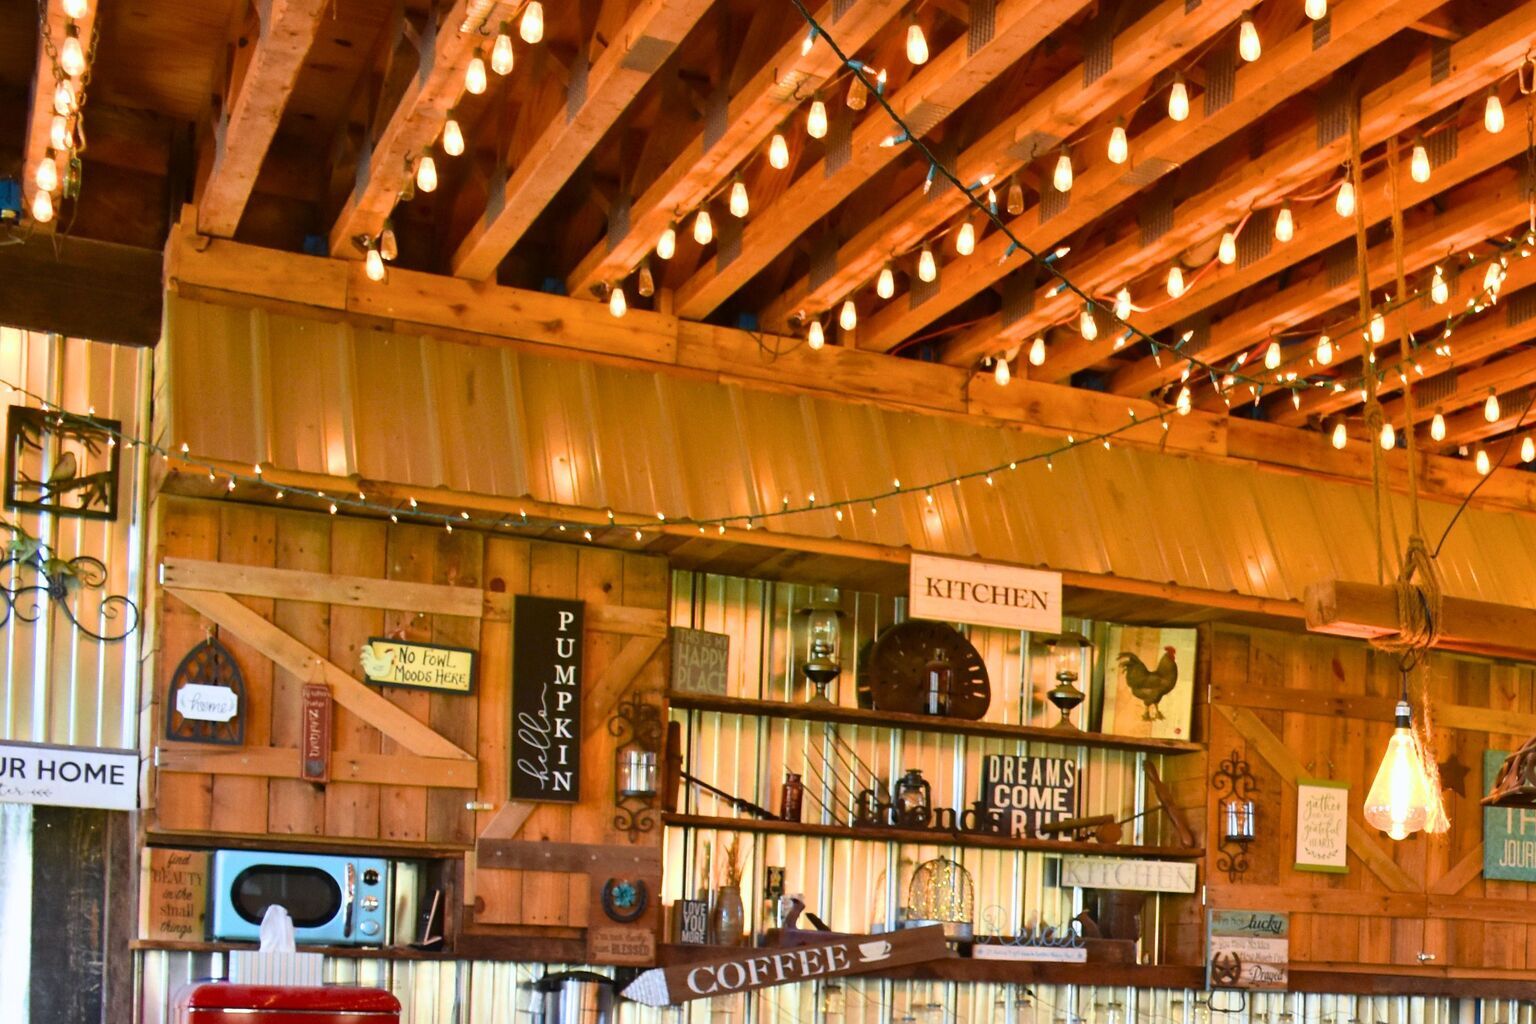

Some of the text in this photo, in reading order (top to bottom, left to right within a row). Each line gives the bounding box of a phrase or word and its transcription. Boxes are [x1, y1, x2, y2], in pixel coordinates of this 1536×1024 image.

[925, 576, 1049, 610] KITCHEN
[399, 647, 456, 668] NO FOWL
[679, 642, 727, 671] HAPPY
[394, 665, 466, 685] MOODS HERE
[677, 666, 726, 696] PLACE
[552, 611, 576, 791] PUMPKIN
[517, 682, 551, 790] hello
[38, 760, 125, 786] HOME
[989, 755, 1074, 788] DREAMS
[994, 785, 1068, 811] COME
[153, 868, 202, 886] BEAUTY
[1065, 860, 1194, 890] KITCHEN
[683, 901, 706, 915] LOVE
[684, 914, 705, 931] YOU
[1240, 914, 1283, 934] lucky
[681, 931, 704, 945] MORE
[687, 944, 850, 994] COFFEE
[1249, 965, 1284, 984] Prayed
